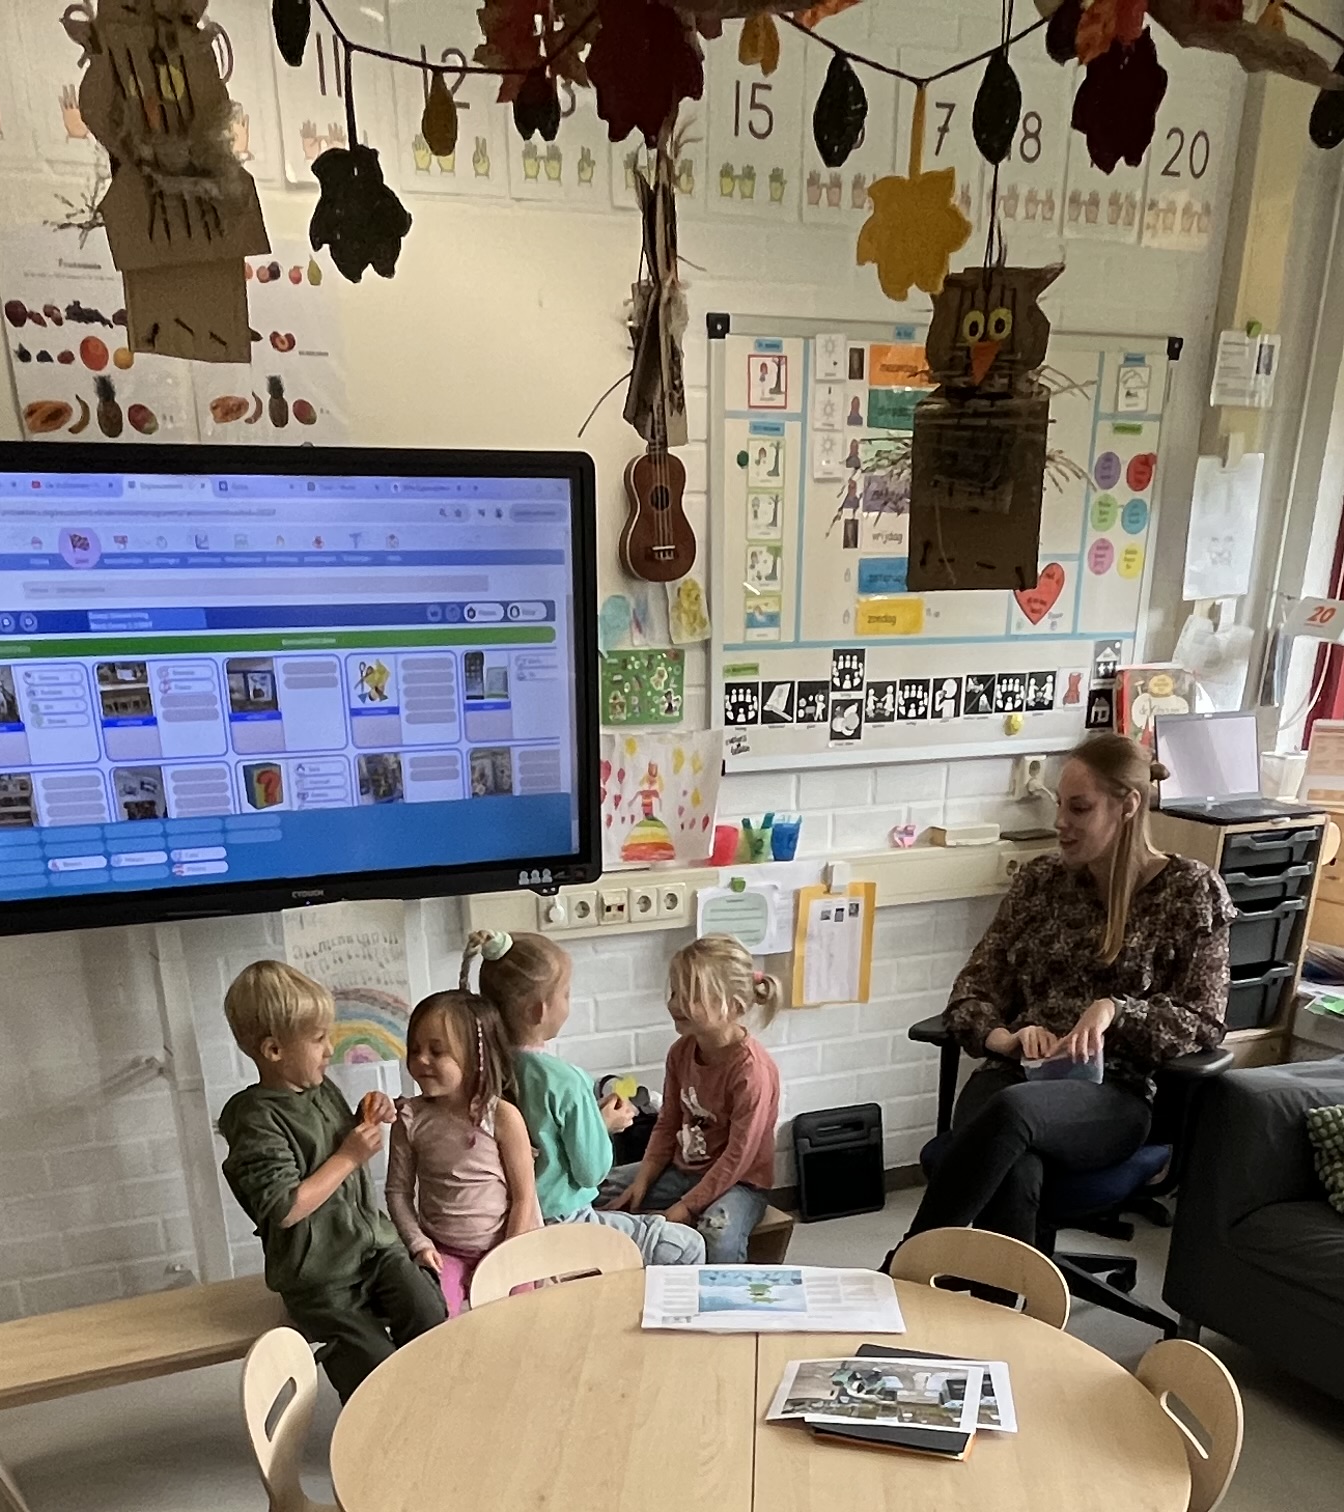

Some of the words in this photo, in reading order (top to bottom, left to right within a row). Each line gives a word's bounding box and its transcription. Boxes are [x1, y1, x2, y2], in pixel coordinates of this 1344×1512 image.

[306, 31, 342, 98] 11
[734, 80, 774, 140] 15
[1160, 127, 1210, 180] 20
[872, 530, 903, 544] vrijdag
[867, 614, 897, 626] zondag
[1306, 606, 1337, 624] 20
